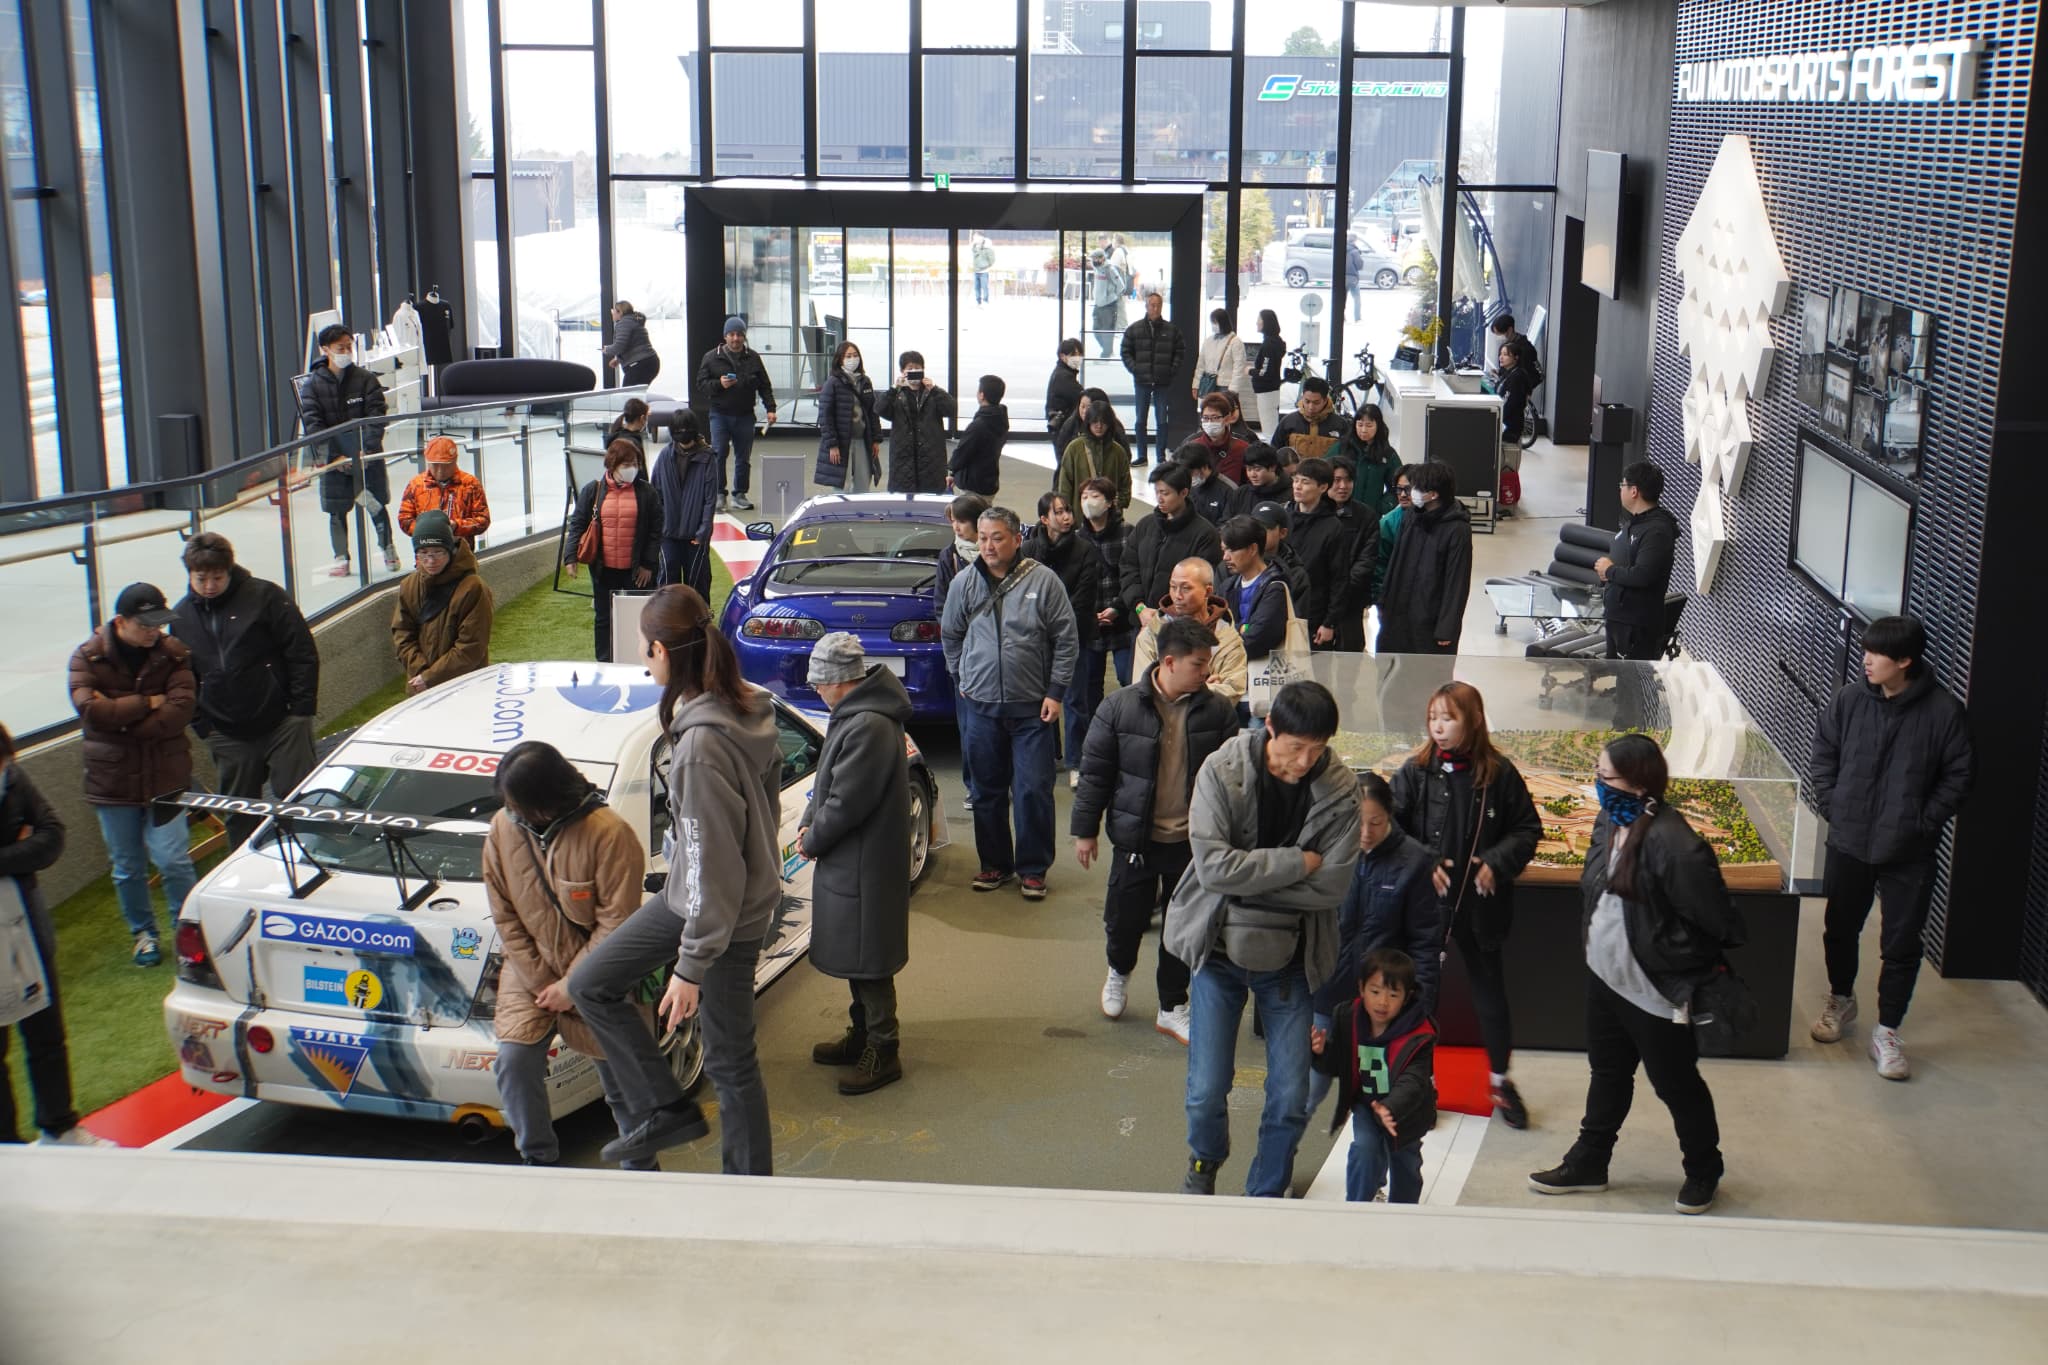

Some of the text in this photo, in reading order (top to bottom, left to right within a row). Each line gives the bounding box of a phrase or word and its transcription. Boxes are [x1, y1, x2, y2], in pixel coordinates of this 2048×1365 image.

[1707, 49, 1849, 102] MOTORSPORTS
[1850, 38, 1972, 102] FOREST
[428, 752, 502, 774] BOS
[300, 921, 411, 949] GAZOO.com
[305, 978, 344, 993] BILSTEIN
[303, 1029, 363, 1046] SPARX
[441, 1049, 498, 1072] NEX
